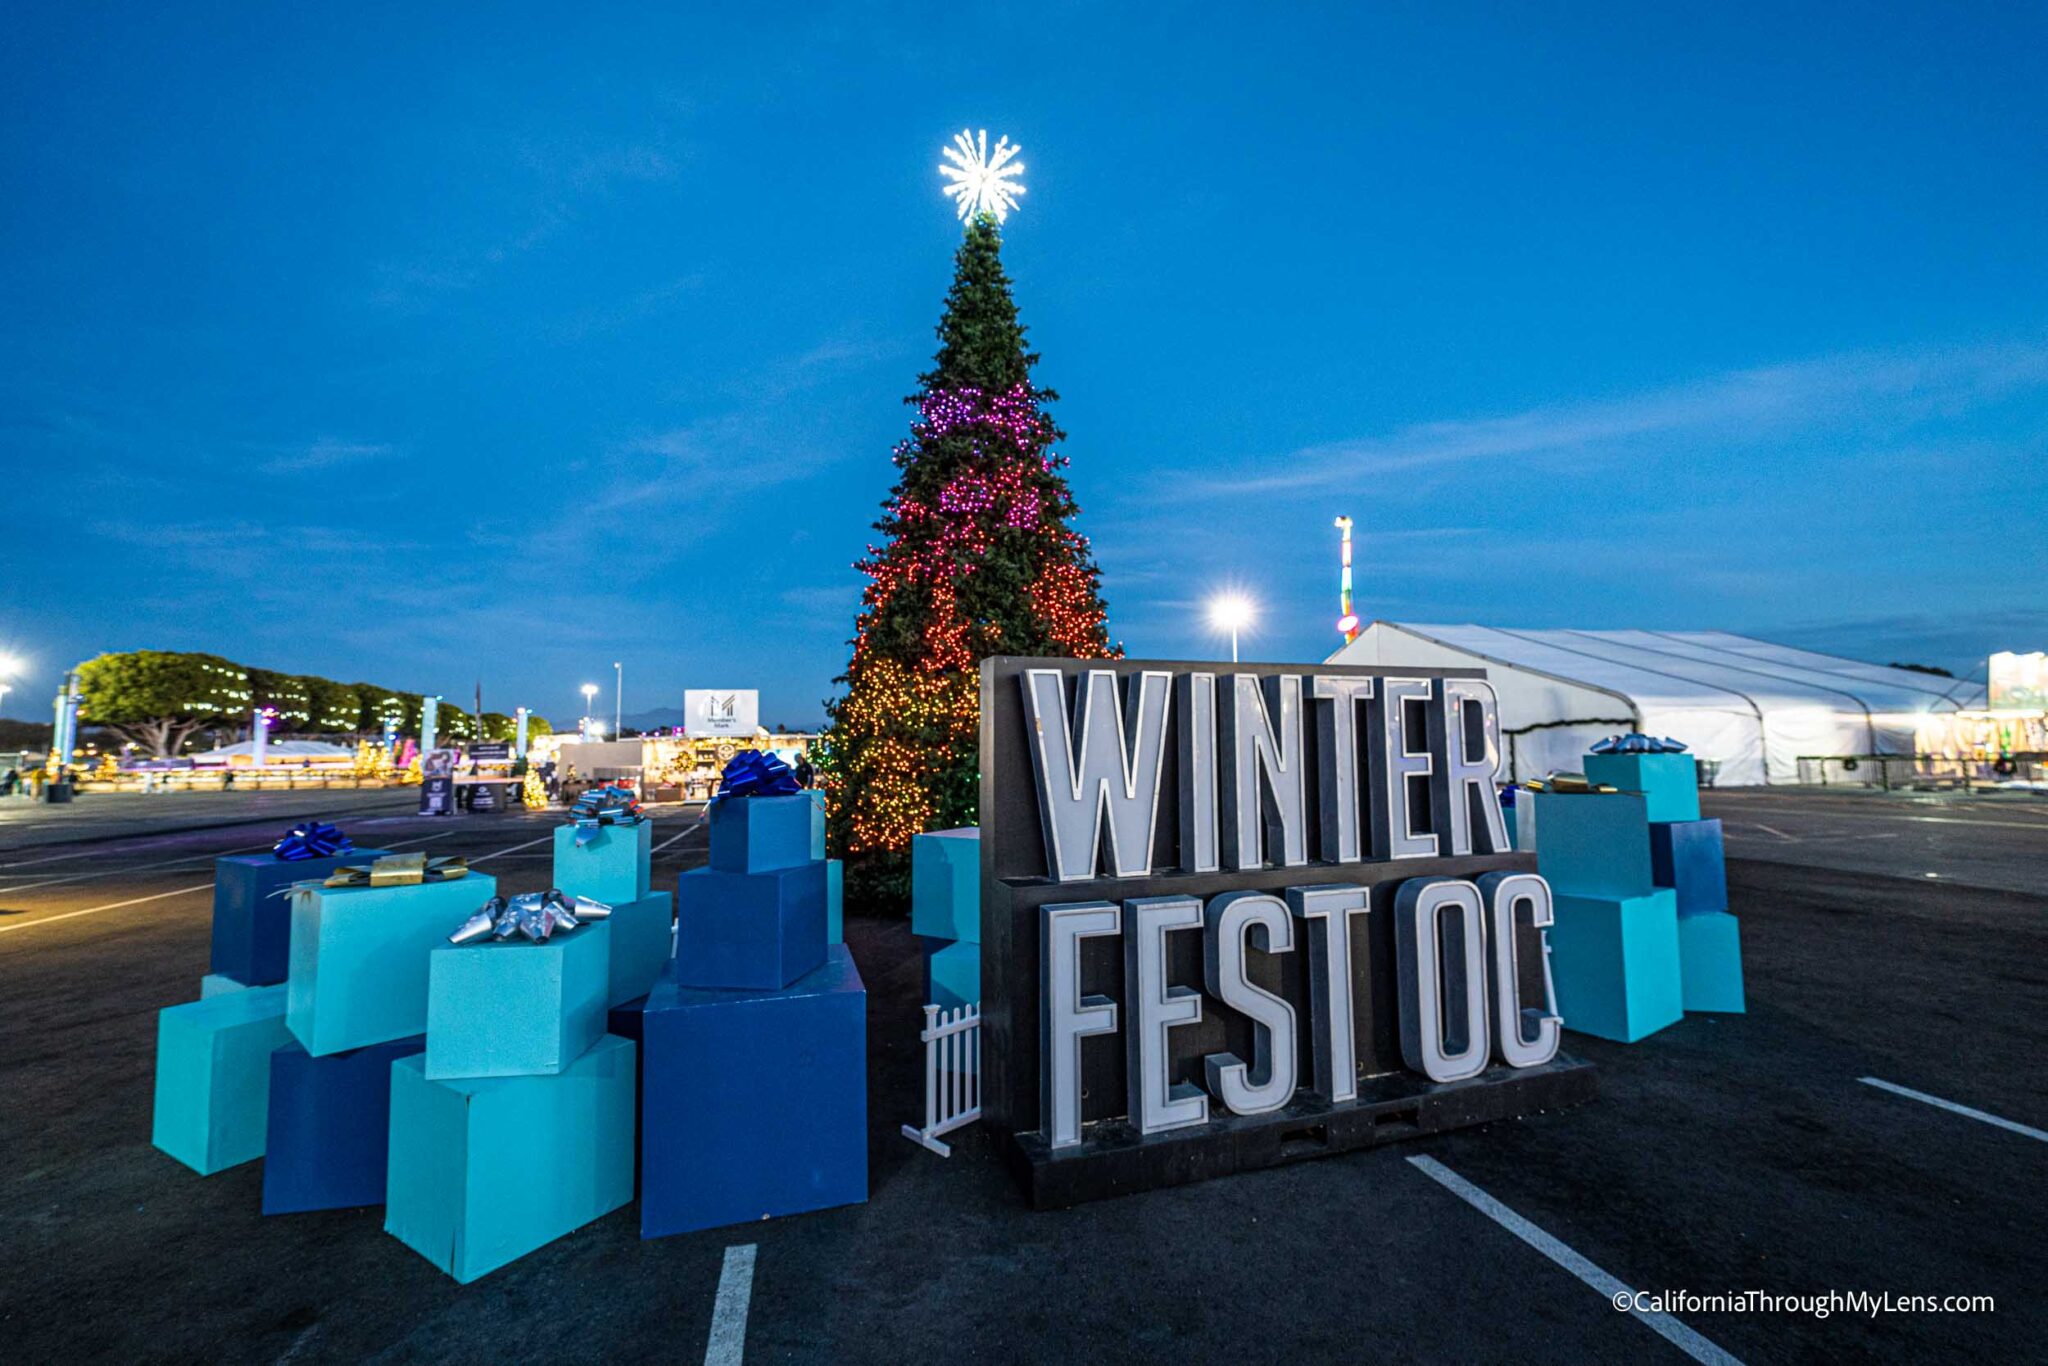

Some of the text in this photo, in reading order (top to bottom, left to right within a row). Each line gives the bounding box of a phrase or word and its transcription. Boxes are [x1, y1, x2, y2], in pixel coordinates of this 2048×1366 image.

[1021, 668, 1512, 882] WINTER
[1040, 873, 1562, 1150] FEST OC
